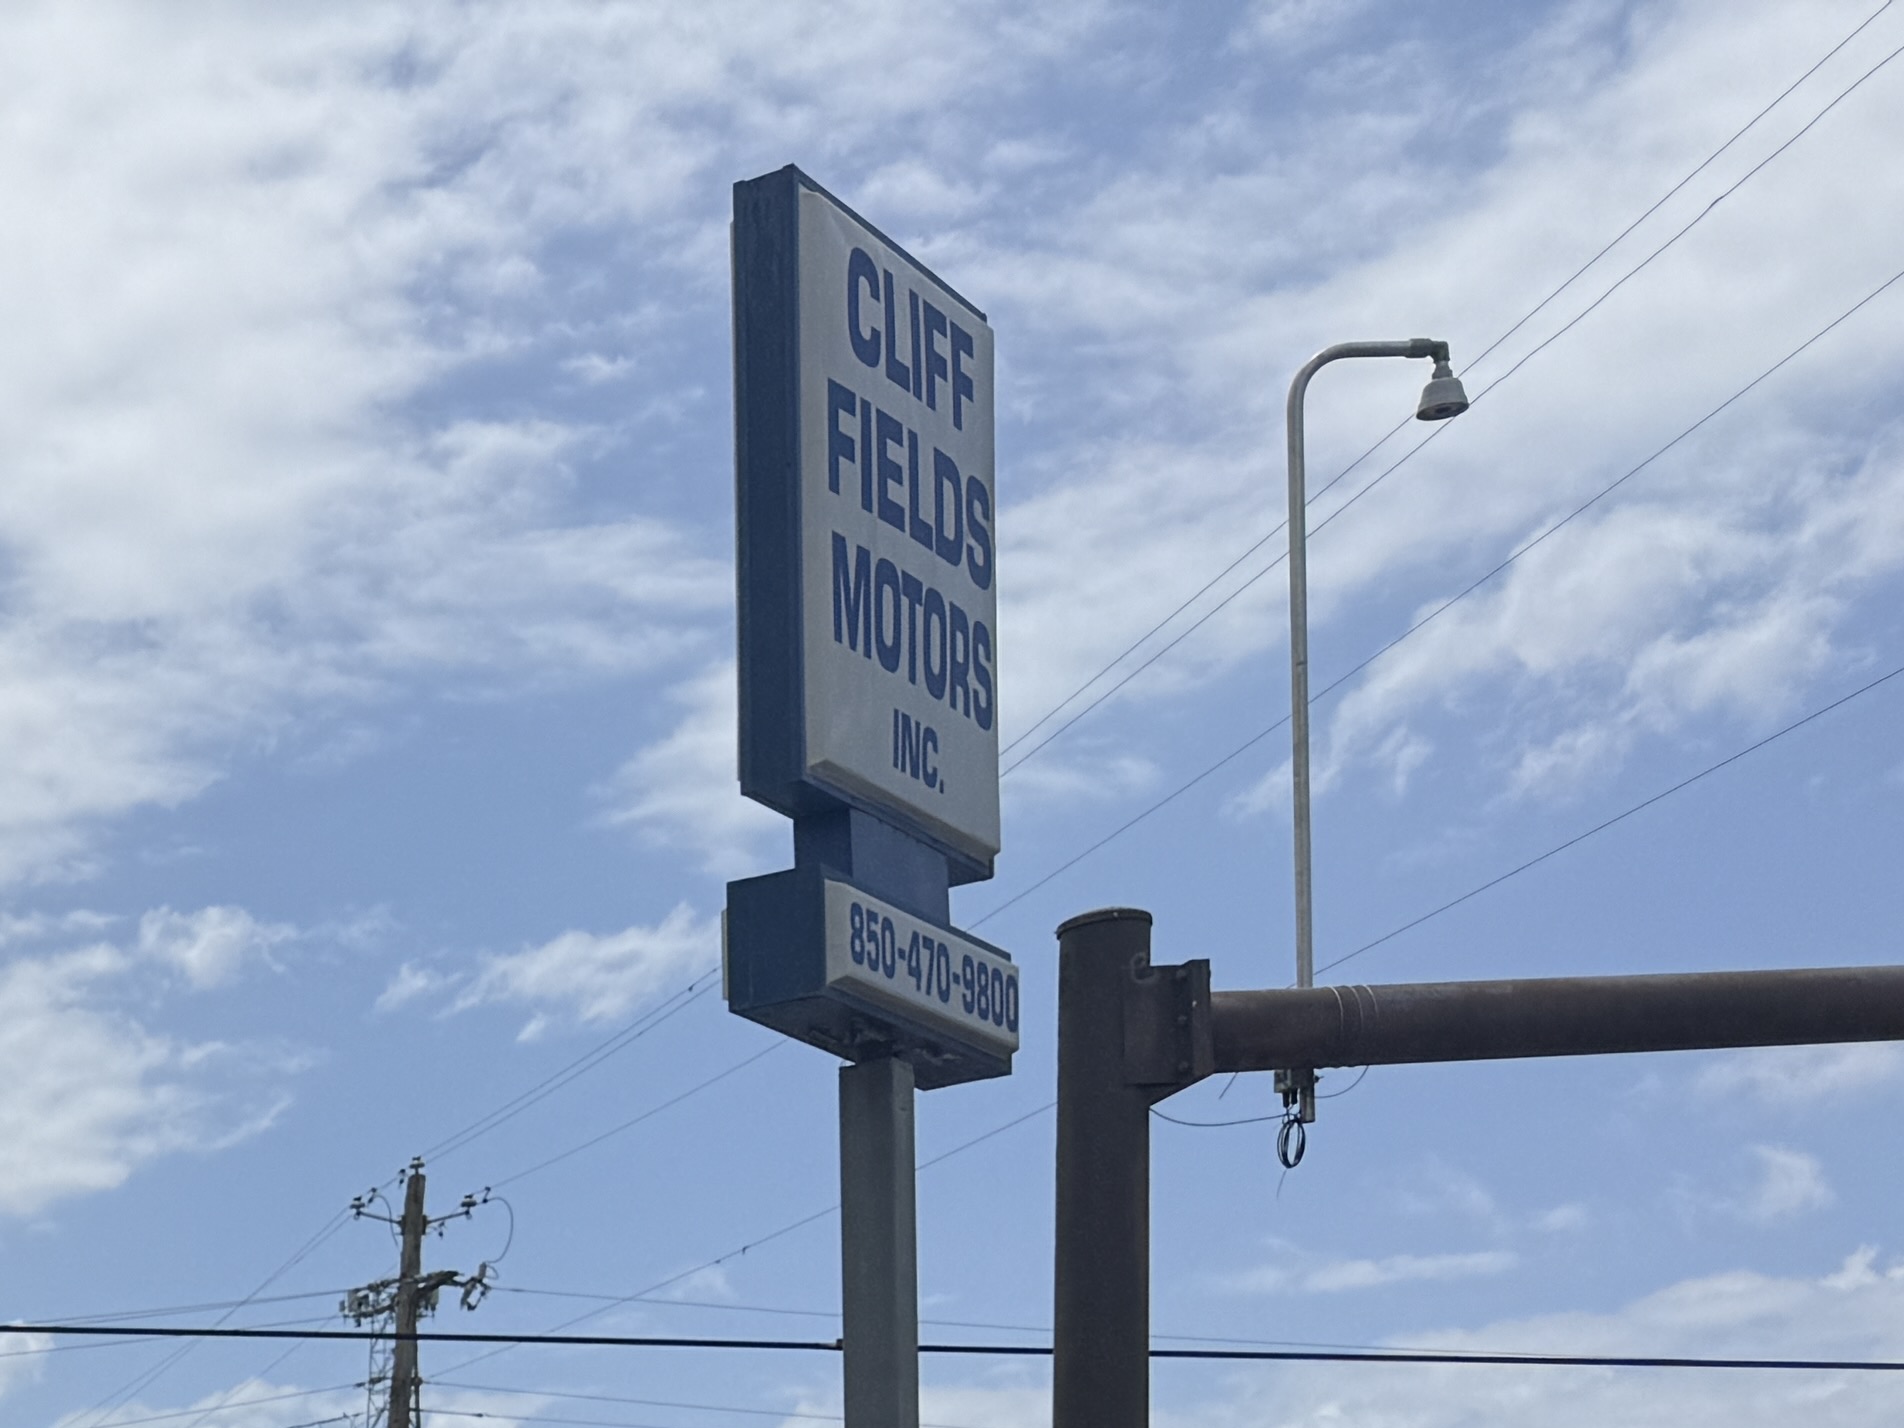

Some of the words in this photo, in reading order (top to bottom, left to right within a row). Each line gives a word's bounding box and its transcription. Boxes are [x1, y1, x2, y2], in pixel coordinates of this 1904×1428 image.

[847, 247, 974, 431] CLIFF
[827, 376, 993, 591] FIELDS
[831, 529, 993, 732] MOTORS
[893, 708, 945, 795] INC.
[850, 901, 1020, 1033] 850-470-9800
